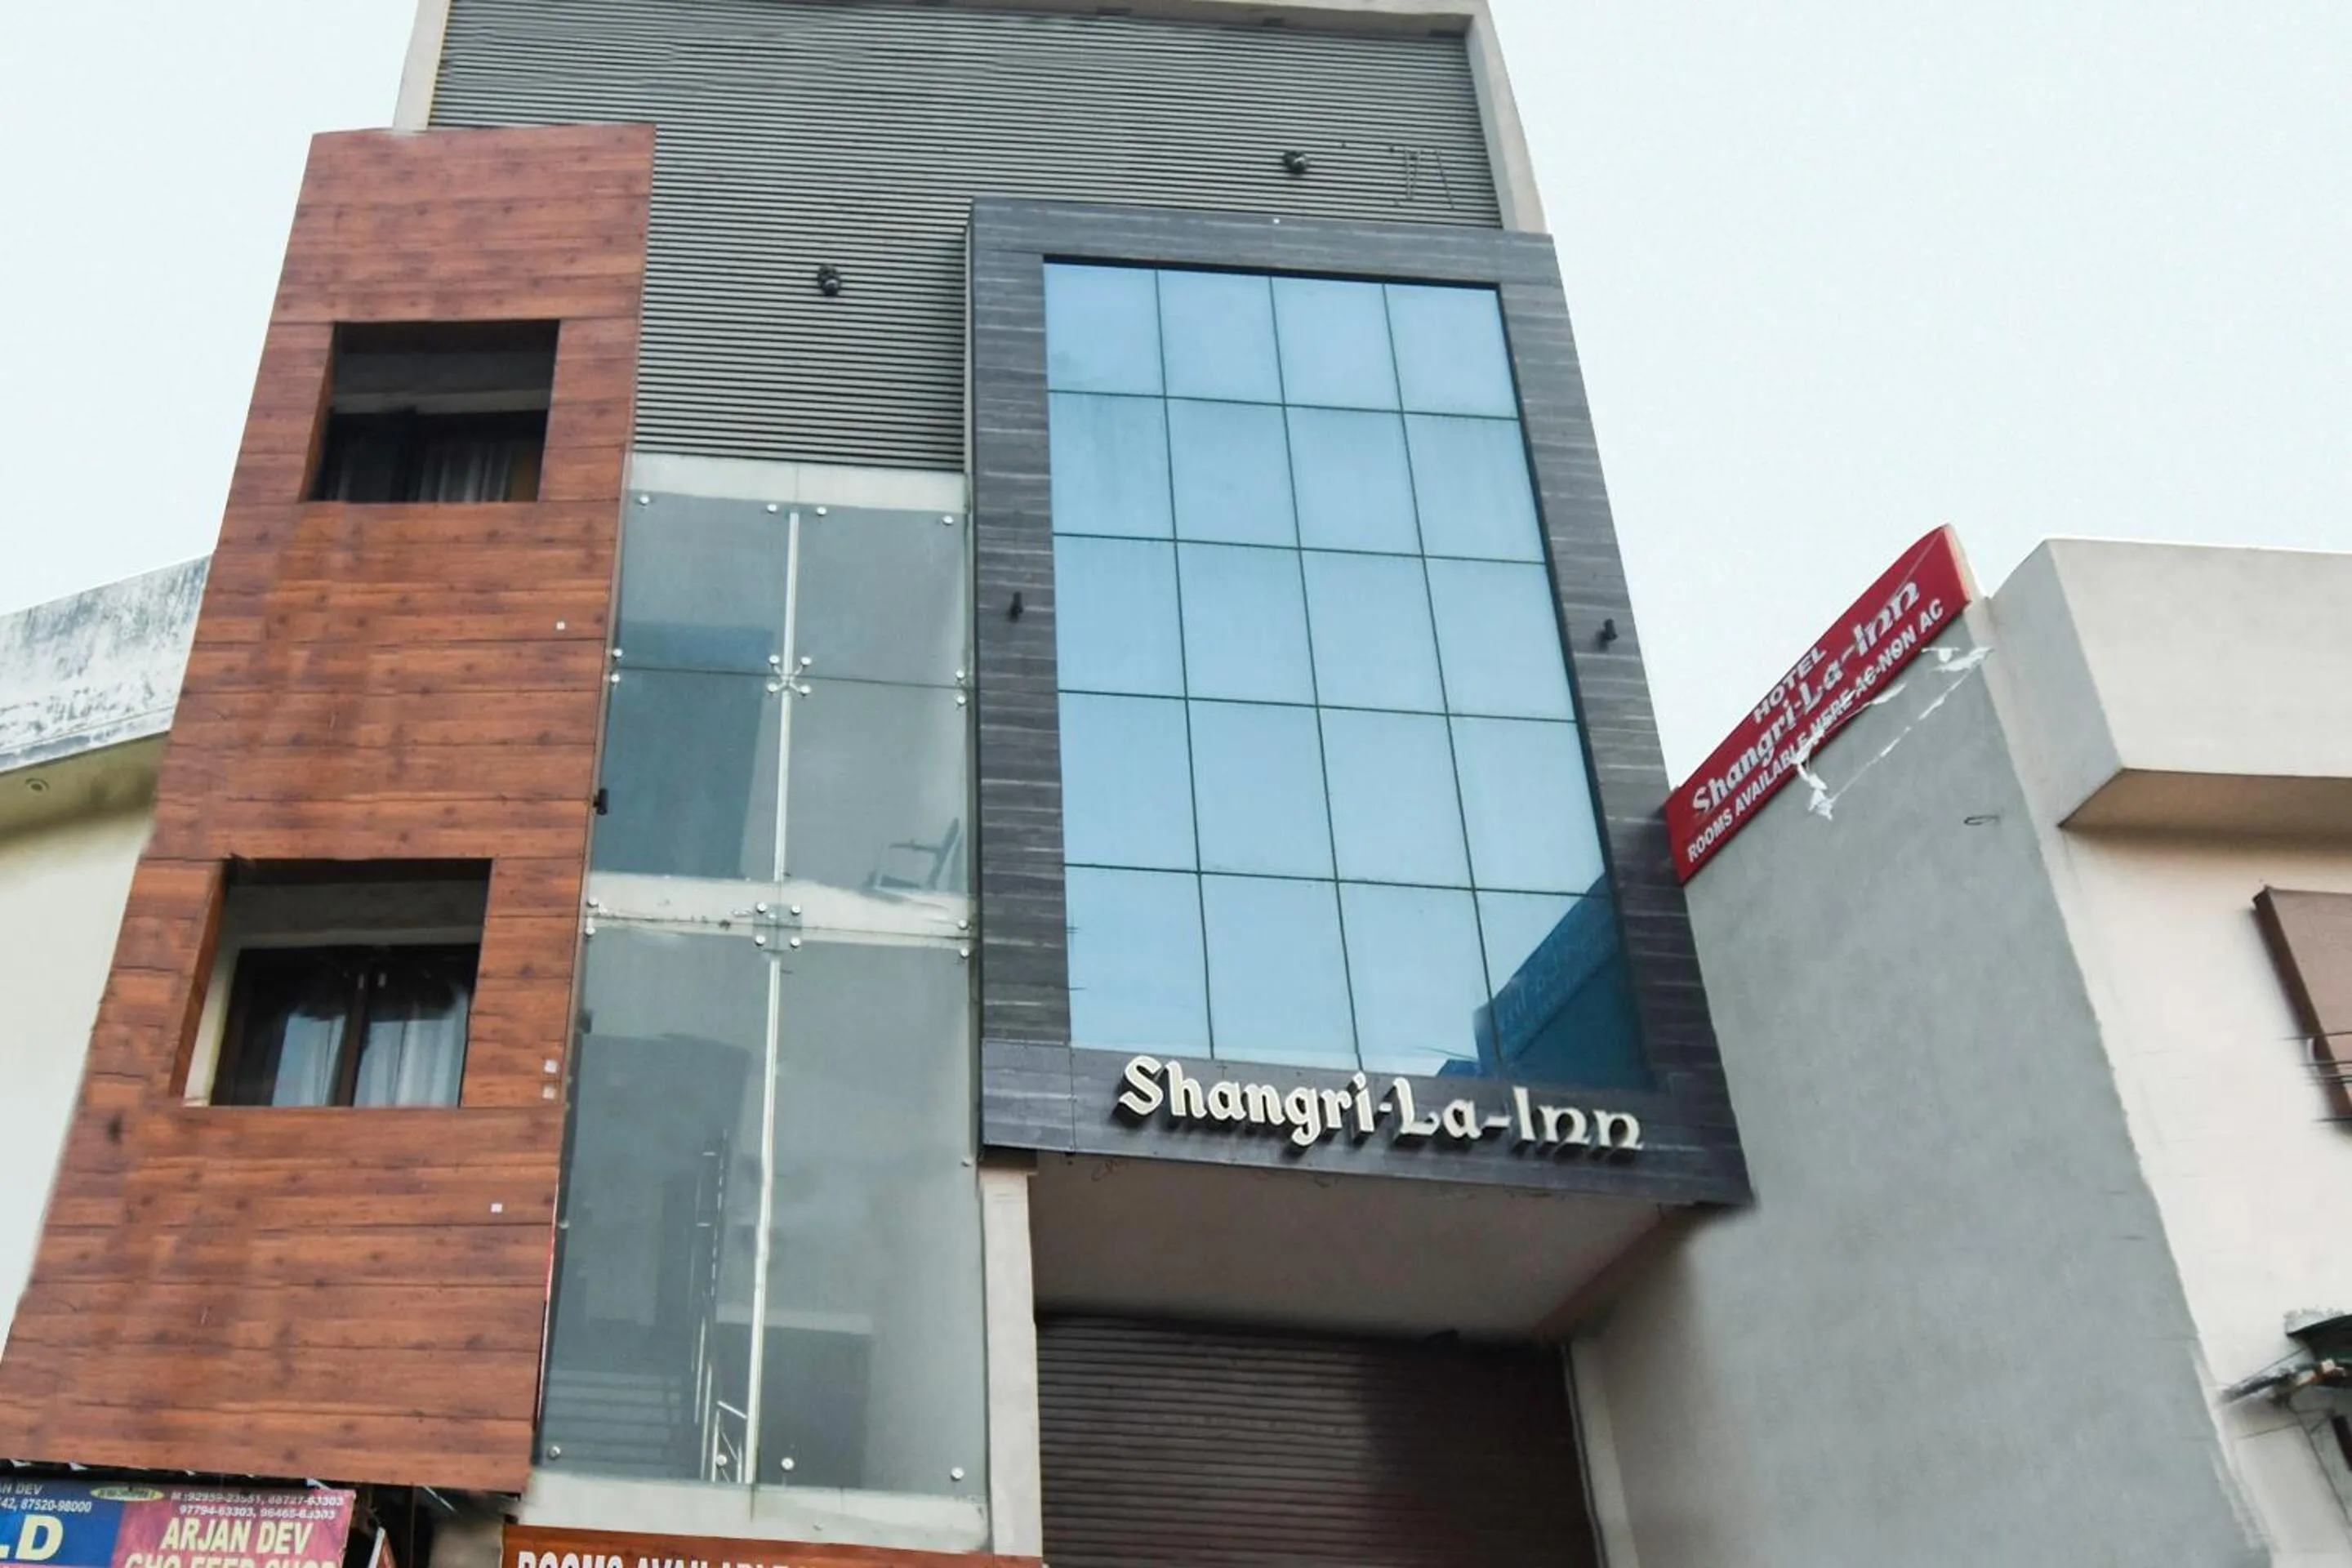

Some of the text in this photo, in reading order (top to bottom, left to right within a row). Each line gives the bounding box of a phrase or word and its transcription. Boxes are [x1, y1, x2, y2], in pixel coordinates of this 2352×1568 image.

[1693, 582, 1919, 813] Shangri-La-Inn
[1754, 647, 1826, 724] HOTEL
[1688, 808, 1733, 862] ROOMS
[1919, 599, 1944, 634] AC
[1120, 1054, 1644, 1150] Shangri-La-Inn
[15, 1482, 42, 1494] DEV
[160, 1517, 314, 1555] ARJAN DEV
